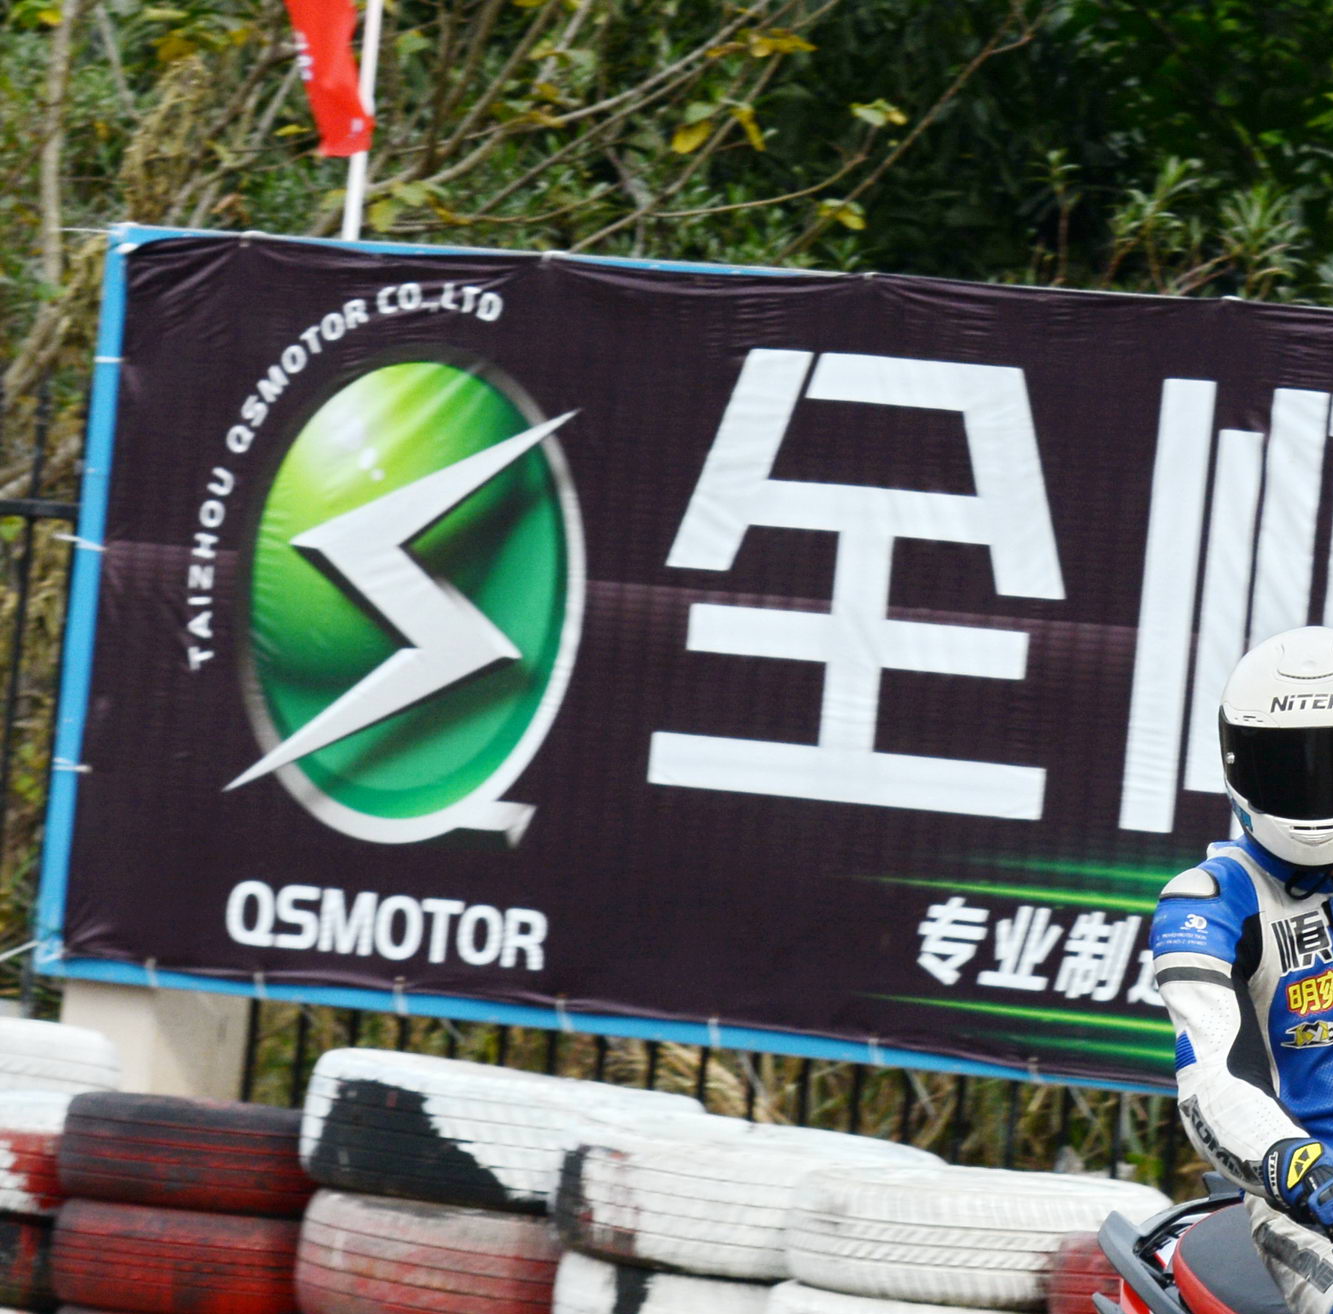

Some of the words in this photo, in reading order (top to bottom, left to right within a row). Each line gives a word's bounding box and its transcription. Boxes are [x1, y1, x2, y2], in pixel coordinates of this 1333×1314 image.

[188, 467, 234, 671] TAIZHOU
[226, 298, 370, 454] QSMOTOR
[226, 881, 548, 971] QSMOTOR
